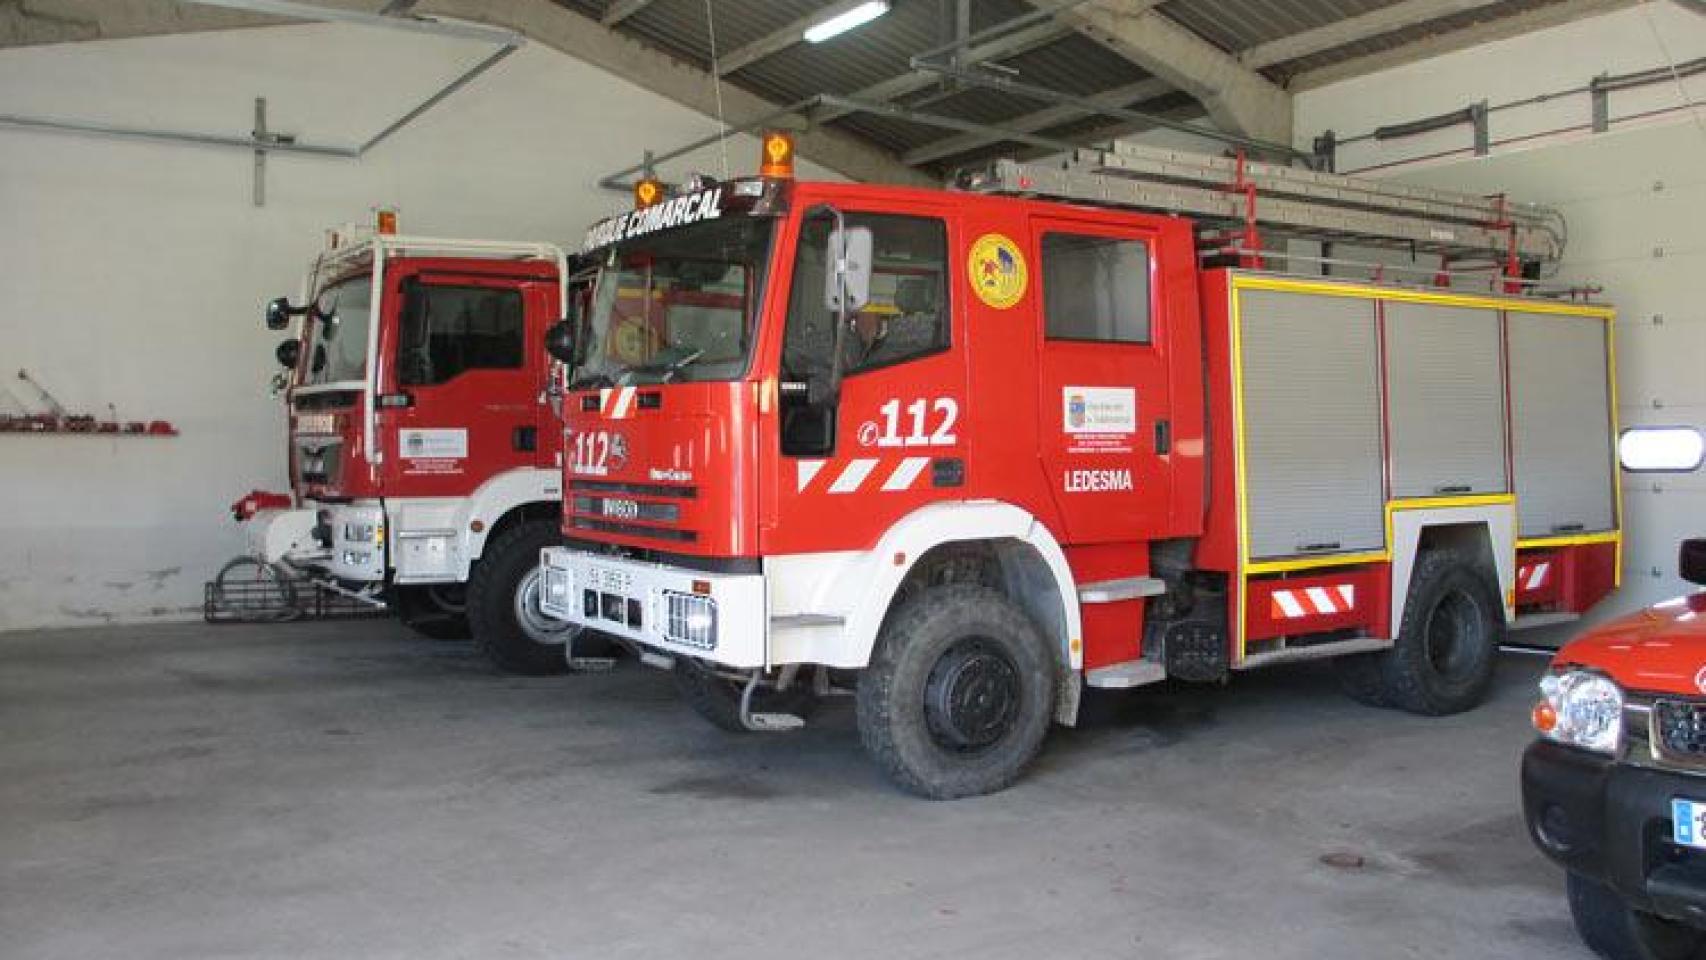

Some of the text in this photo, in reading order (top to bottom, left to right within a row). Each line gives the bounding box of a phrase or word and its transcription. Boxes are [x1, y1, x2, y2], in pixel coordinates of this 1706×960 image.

[627, 188, 722, 238] COMARCAL
[878, 397, 958, 447] 112
[574, 431, 608, 476] 112
[1064, 469, 1134, 492] LEDESMA
